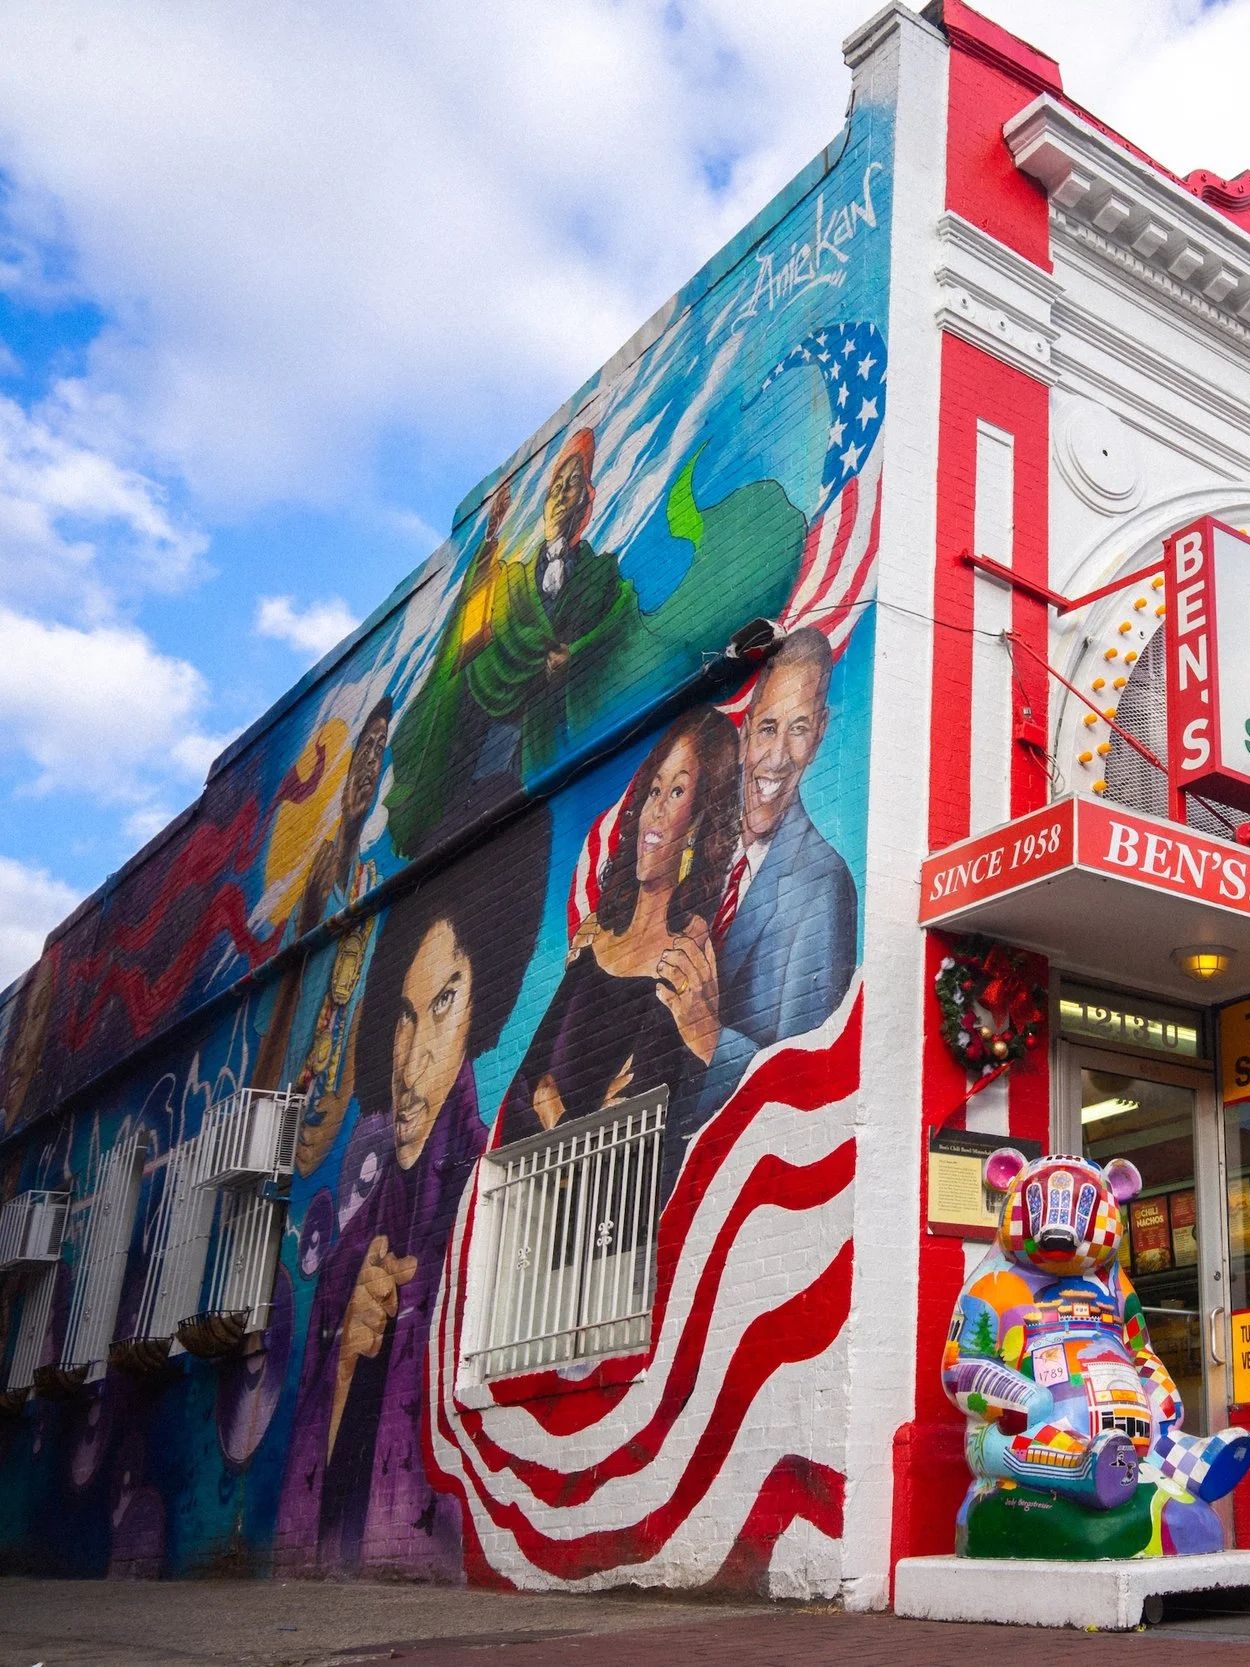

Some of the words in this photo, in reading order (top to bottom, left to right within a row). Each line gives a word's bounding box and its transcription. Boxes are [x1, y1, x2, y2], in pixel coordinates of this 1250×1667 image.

[1175, 531, 1211, 772] BEN'S
[929, 846, 1005, 901] SINCE
[1009, 823, 1062, 871] 1958
[1079, 1002, 1150, 1041] 1213
[1136, 1215, 1164, 1228] NACHOS
[1038, 1367, 1064, 1382] 1789
